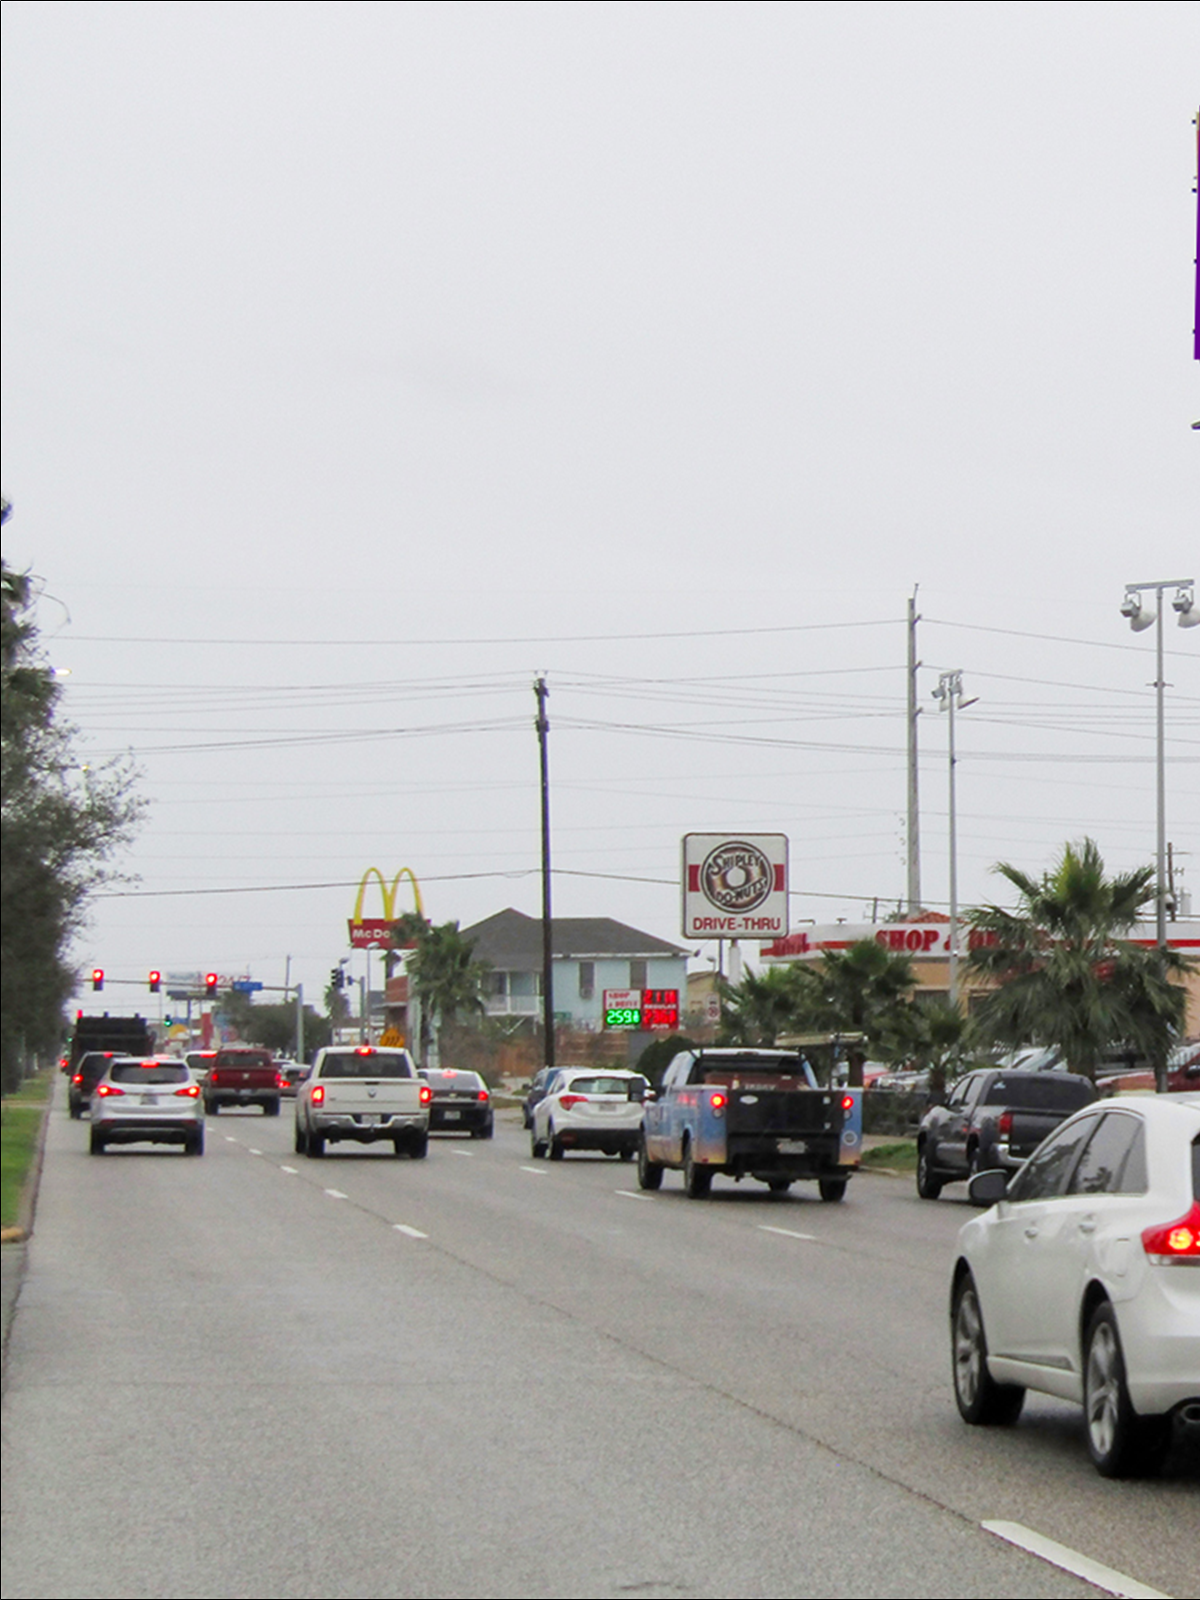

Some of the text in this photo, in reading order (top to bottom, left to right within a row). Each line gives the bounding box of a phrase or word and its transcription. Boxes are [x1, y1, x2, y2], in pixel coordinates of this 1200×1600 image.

[709, 853, 761, 876] SHIPLEY
[693, 917, 781, 930] DRIVE-THRU
[875, 929, 940, 952] SHOP
